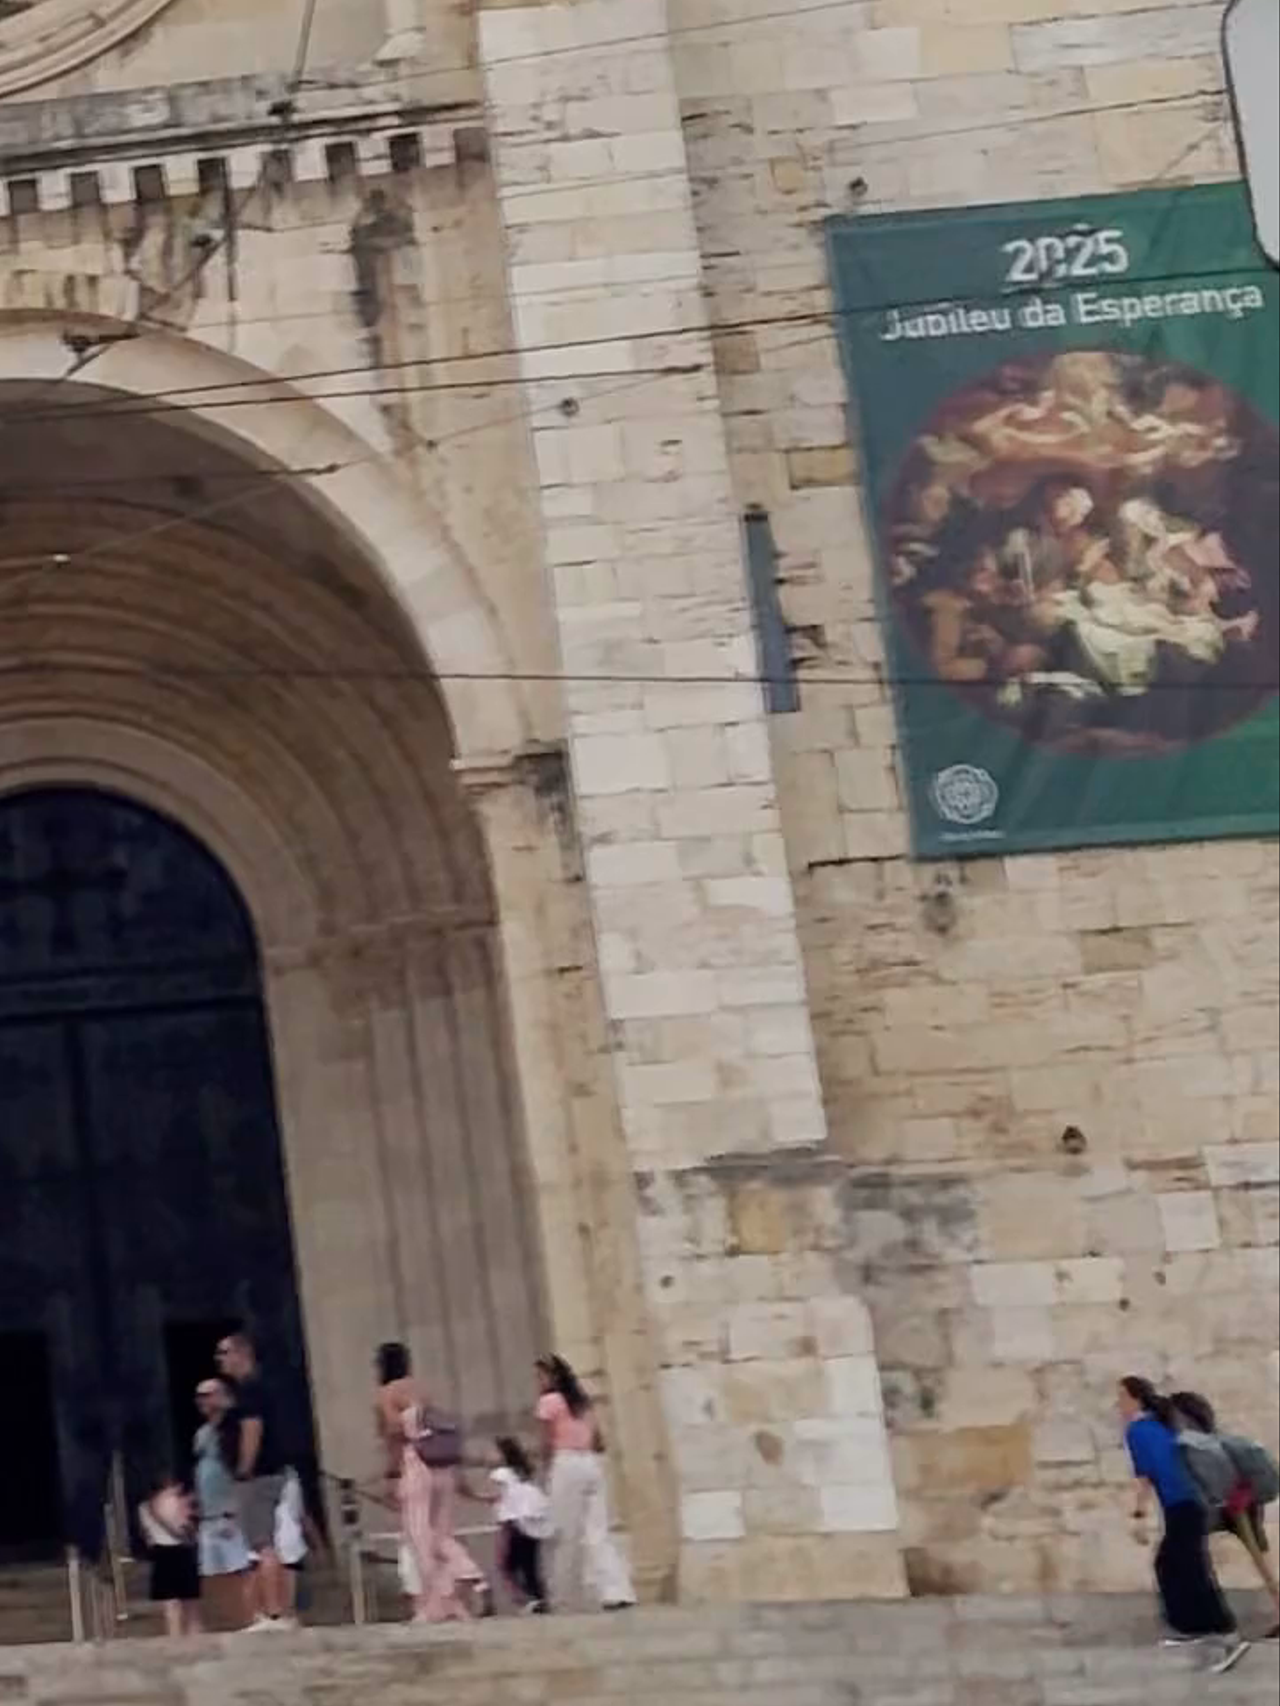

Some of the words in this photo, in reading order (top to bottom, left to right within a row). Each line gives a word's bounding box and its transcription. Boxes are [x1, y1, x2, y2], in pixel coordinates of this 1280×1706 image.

[1002, 227, 1130, 283] 2025
[880, 303, 1011, 341] Jubileu
[1022, 296, 1067, 328] da
[1075, 284, 1264, 329] Esperança
